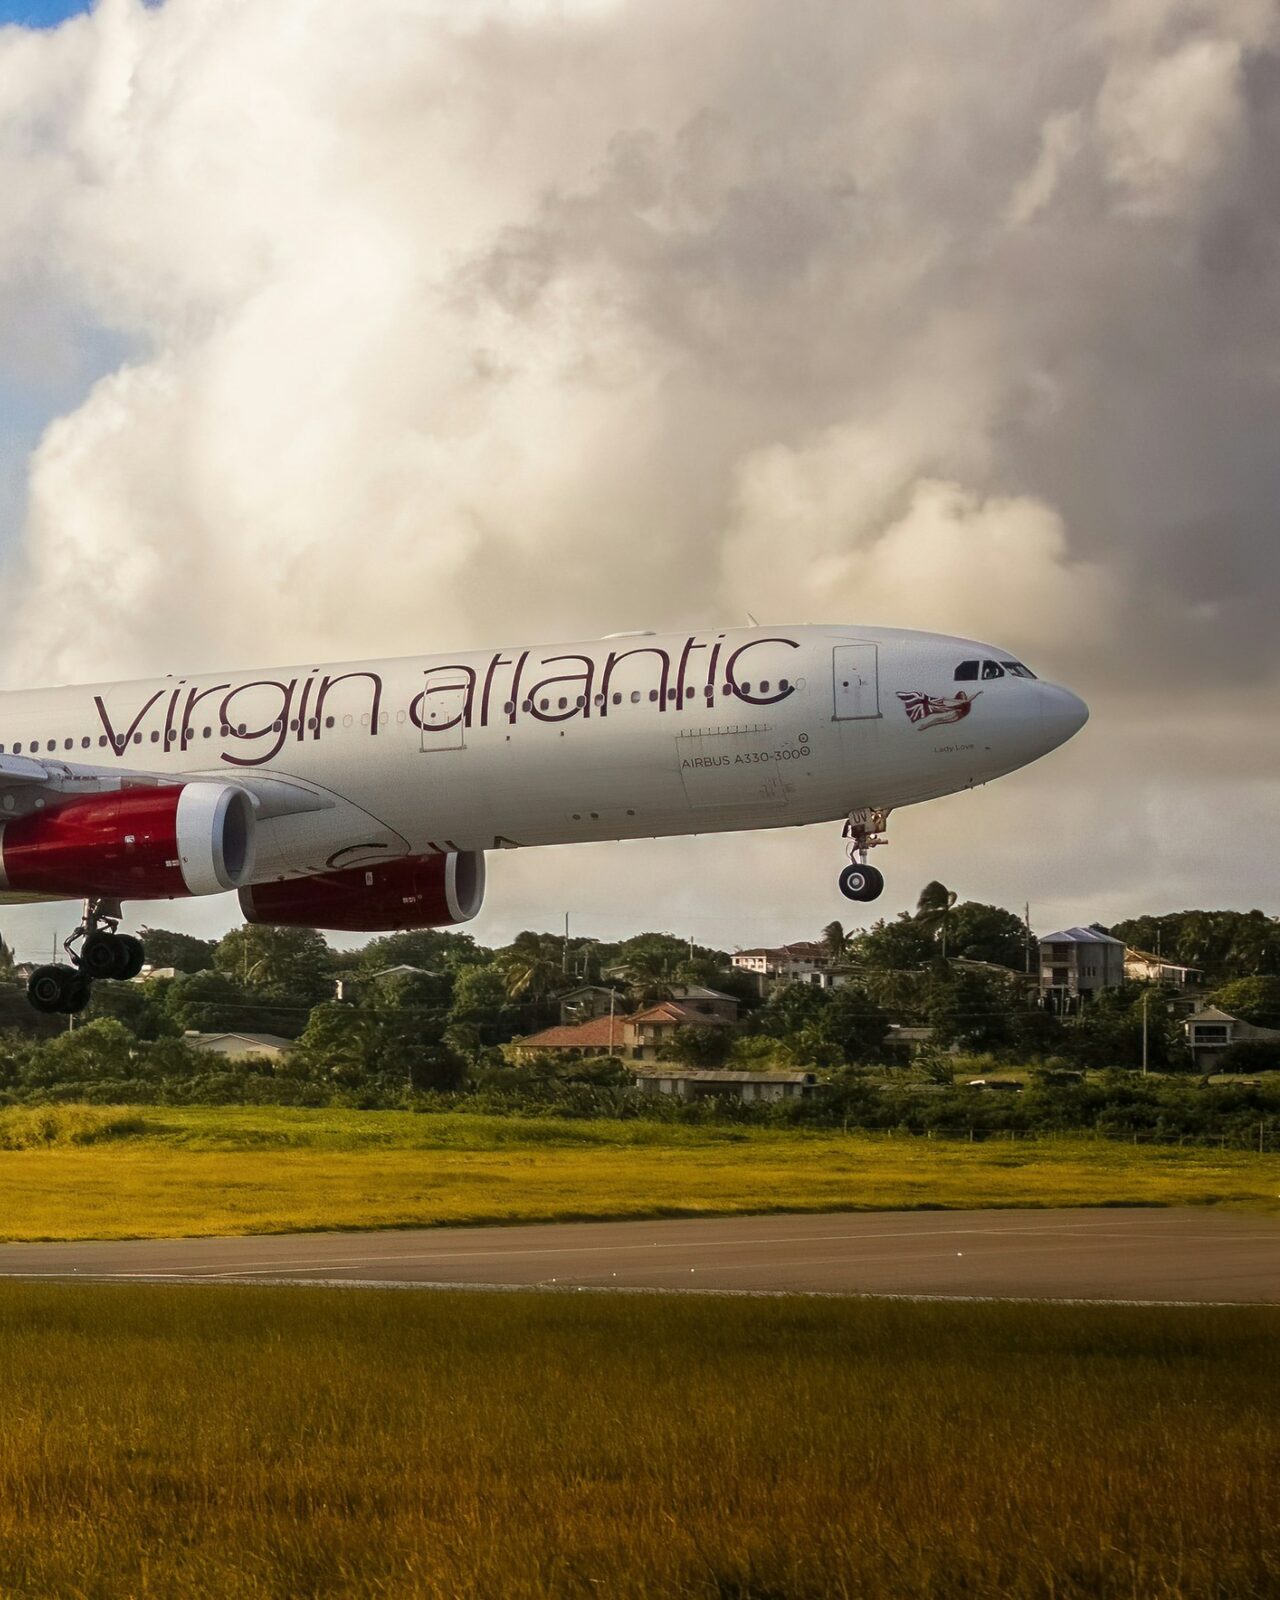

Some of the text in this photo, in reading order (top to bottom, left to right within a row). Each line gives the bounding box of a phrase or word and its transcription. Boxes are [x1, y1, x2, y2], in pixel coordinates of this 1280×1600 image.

[94, 634, 801, 766] virgin atlantic
[682, 749, 800, 769] AIRBUS A330-300
[852, 810, 867, 823] UV
